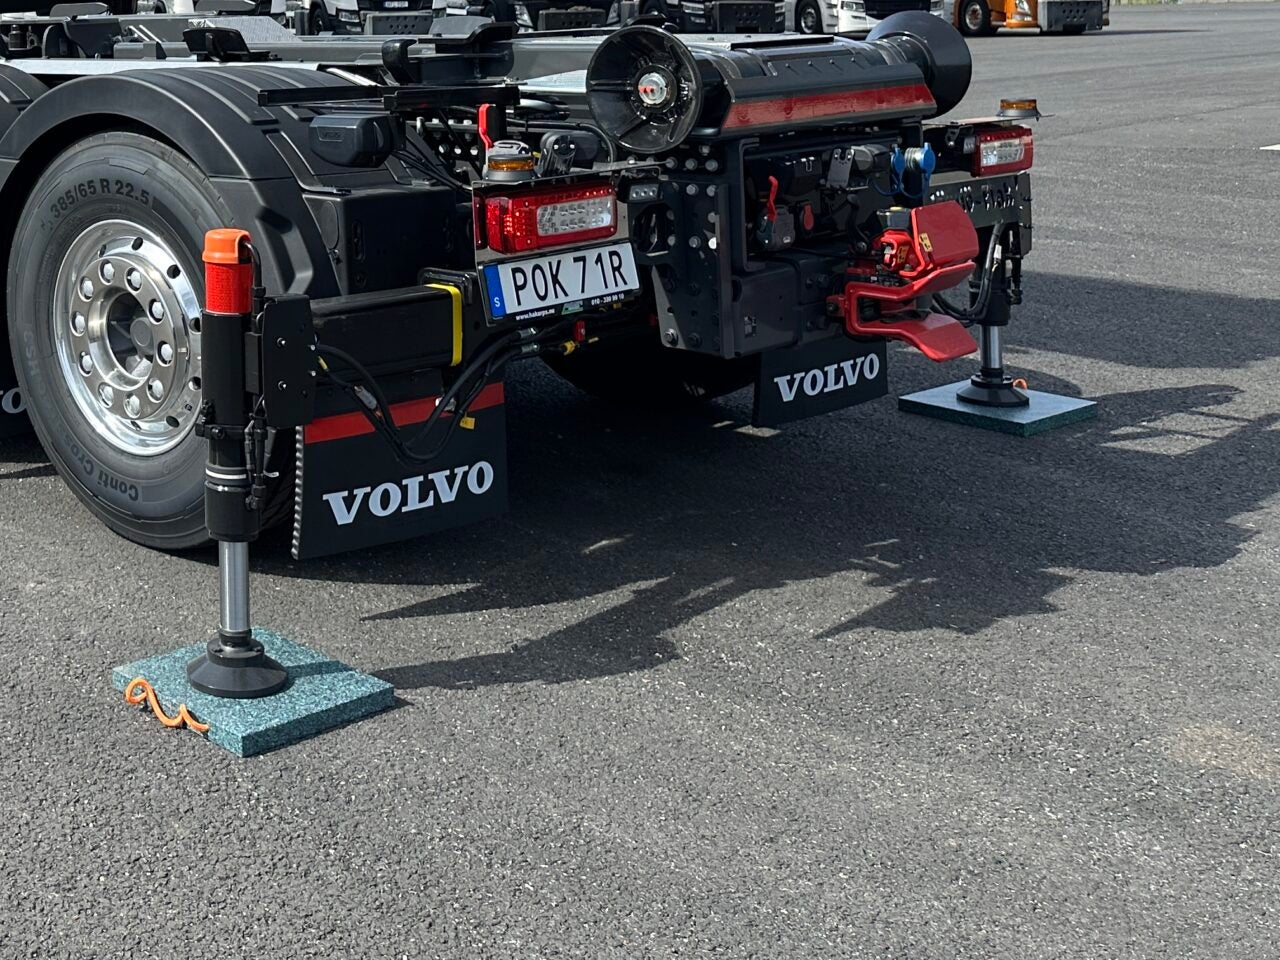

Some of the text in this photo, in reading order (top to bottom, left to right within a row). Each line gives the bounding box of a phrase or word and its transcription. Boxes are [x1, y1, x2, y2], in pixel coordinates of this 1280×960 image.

[50, 178, 150, 219] 385/65 R 22.5
[511, 250, 628, 306] POK 71R
[494, 297, 501, 307] S
[773, 353, 880, 402] VOLVO
[97, 469, 138, 501] Conti
[322, 460, 494, 526] VOLVO
